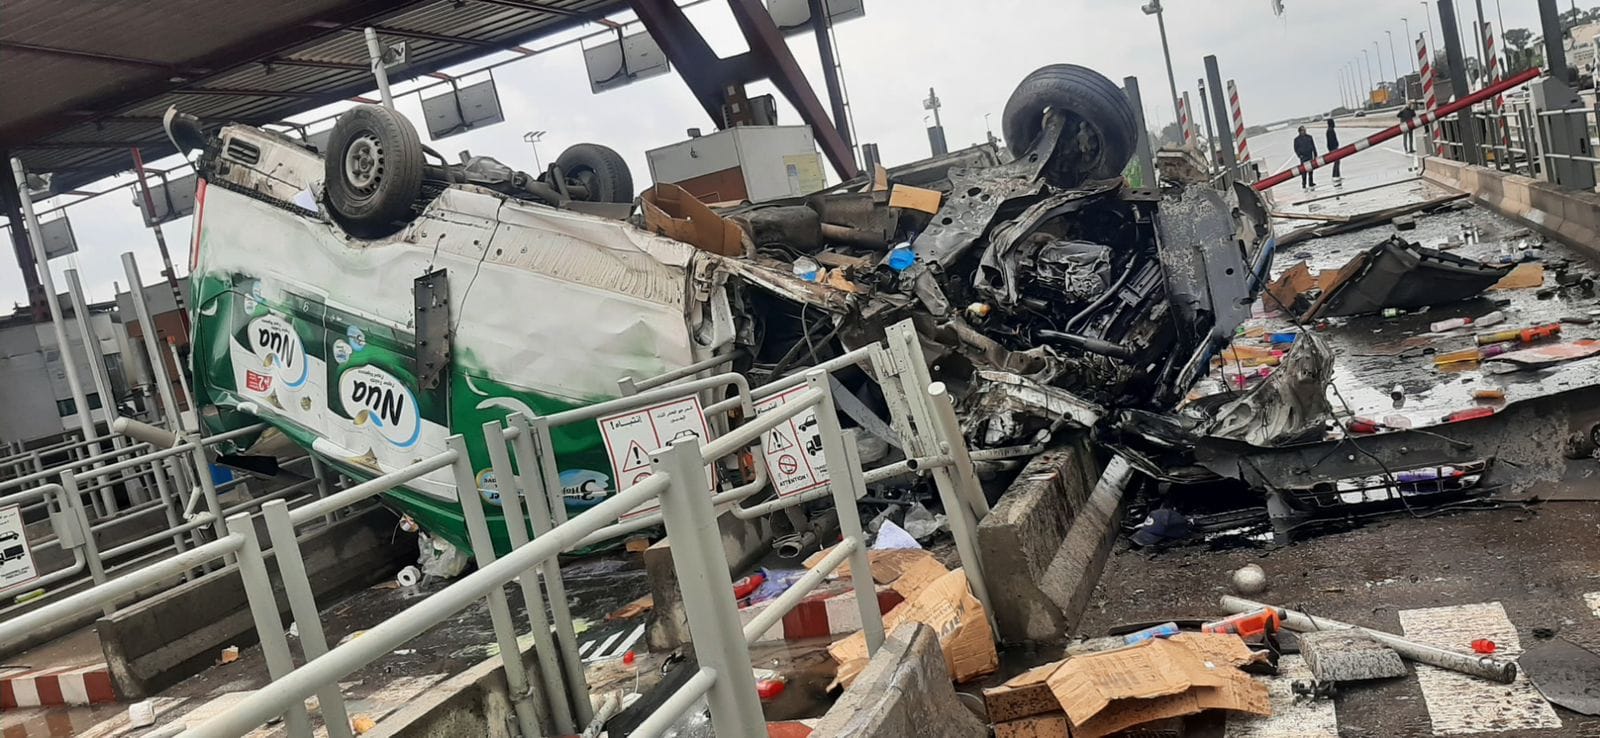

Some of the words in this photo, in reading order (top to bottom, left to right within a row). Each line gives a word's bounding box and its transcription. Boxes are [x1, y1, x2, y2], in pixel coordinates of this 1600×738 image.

[258, 327, 295, 368] Nua
[352, 380, 404, 426] Nua
[580, 479, 596, 501] 3
